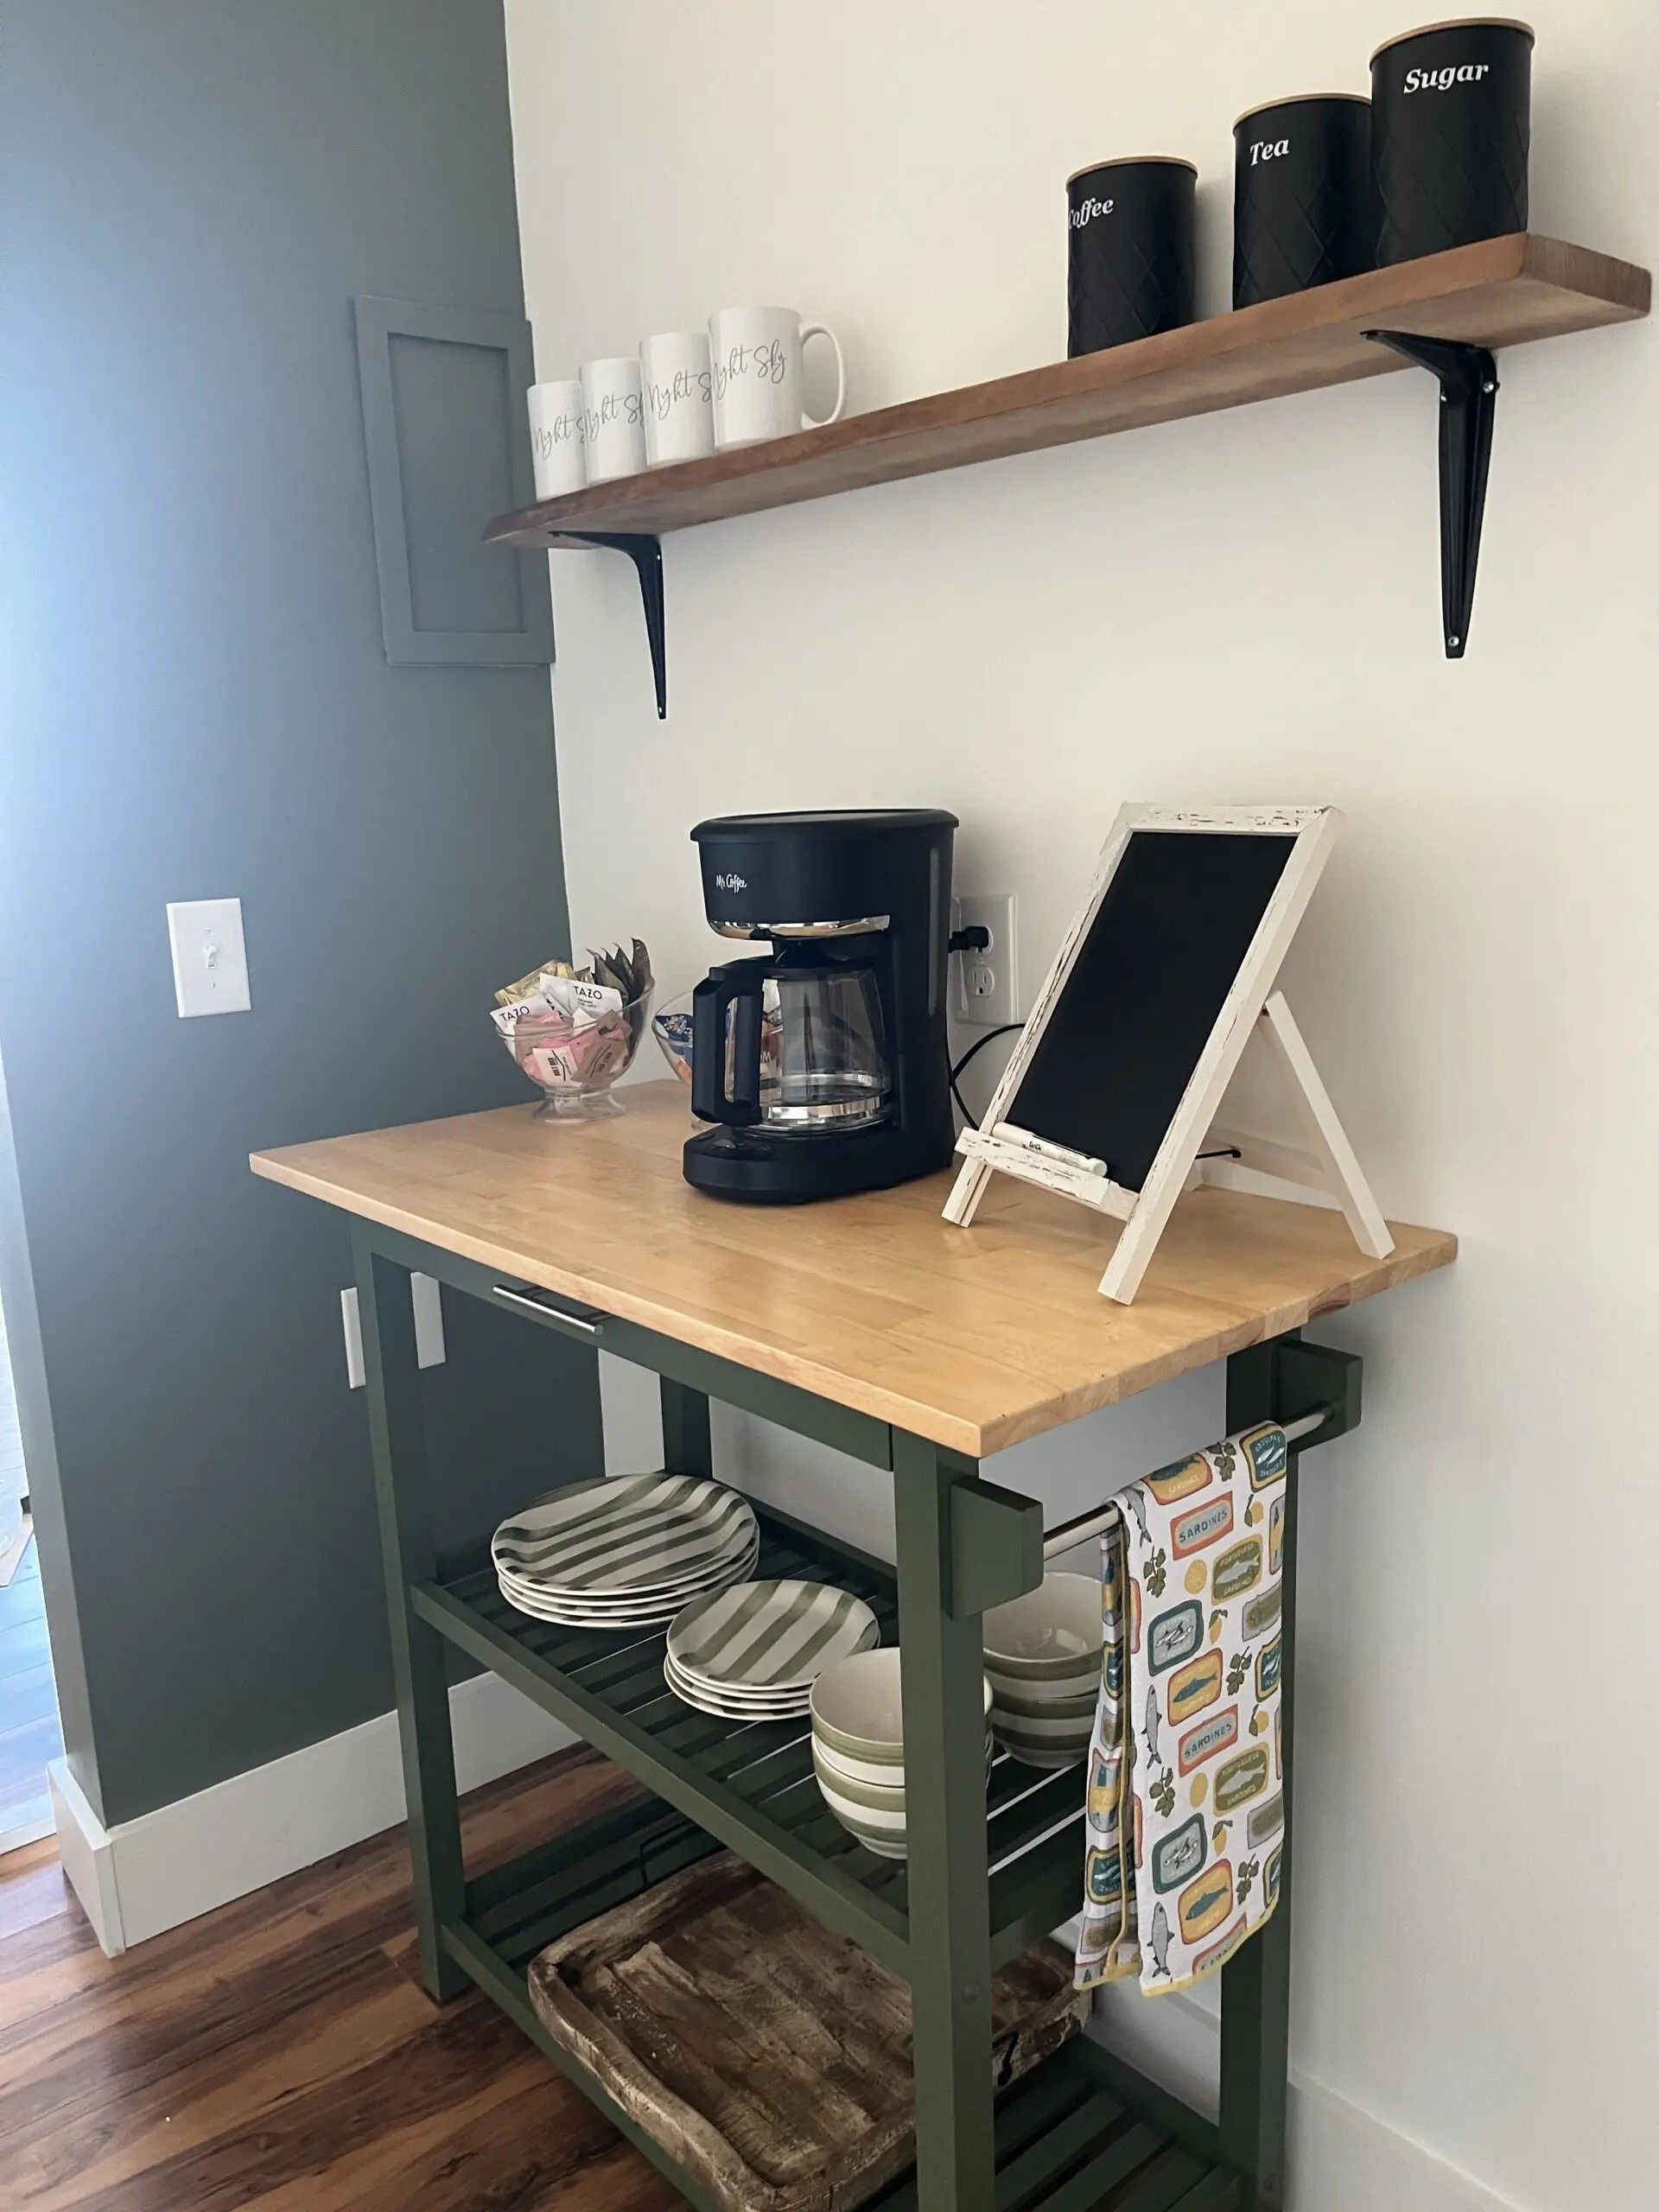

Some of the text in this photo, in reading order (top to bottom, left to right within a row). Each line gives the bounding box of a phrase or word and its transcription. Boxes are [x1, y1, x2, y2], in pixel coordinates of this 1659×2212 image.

[1403, 63, 1489, 93] Sugar
[1250, 137, 1290, 166] Tea
[753, 339, 787, 385] Sky
[726, 874, 747, 893] Coffee
[574, 985, 602, 1000] TAZO
[1179, 1509, 1227, 1542] SARDINES
[1183, 1722, 1232, 1759] SARDINES
